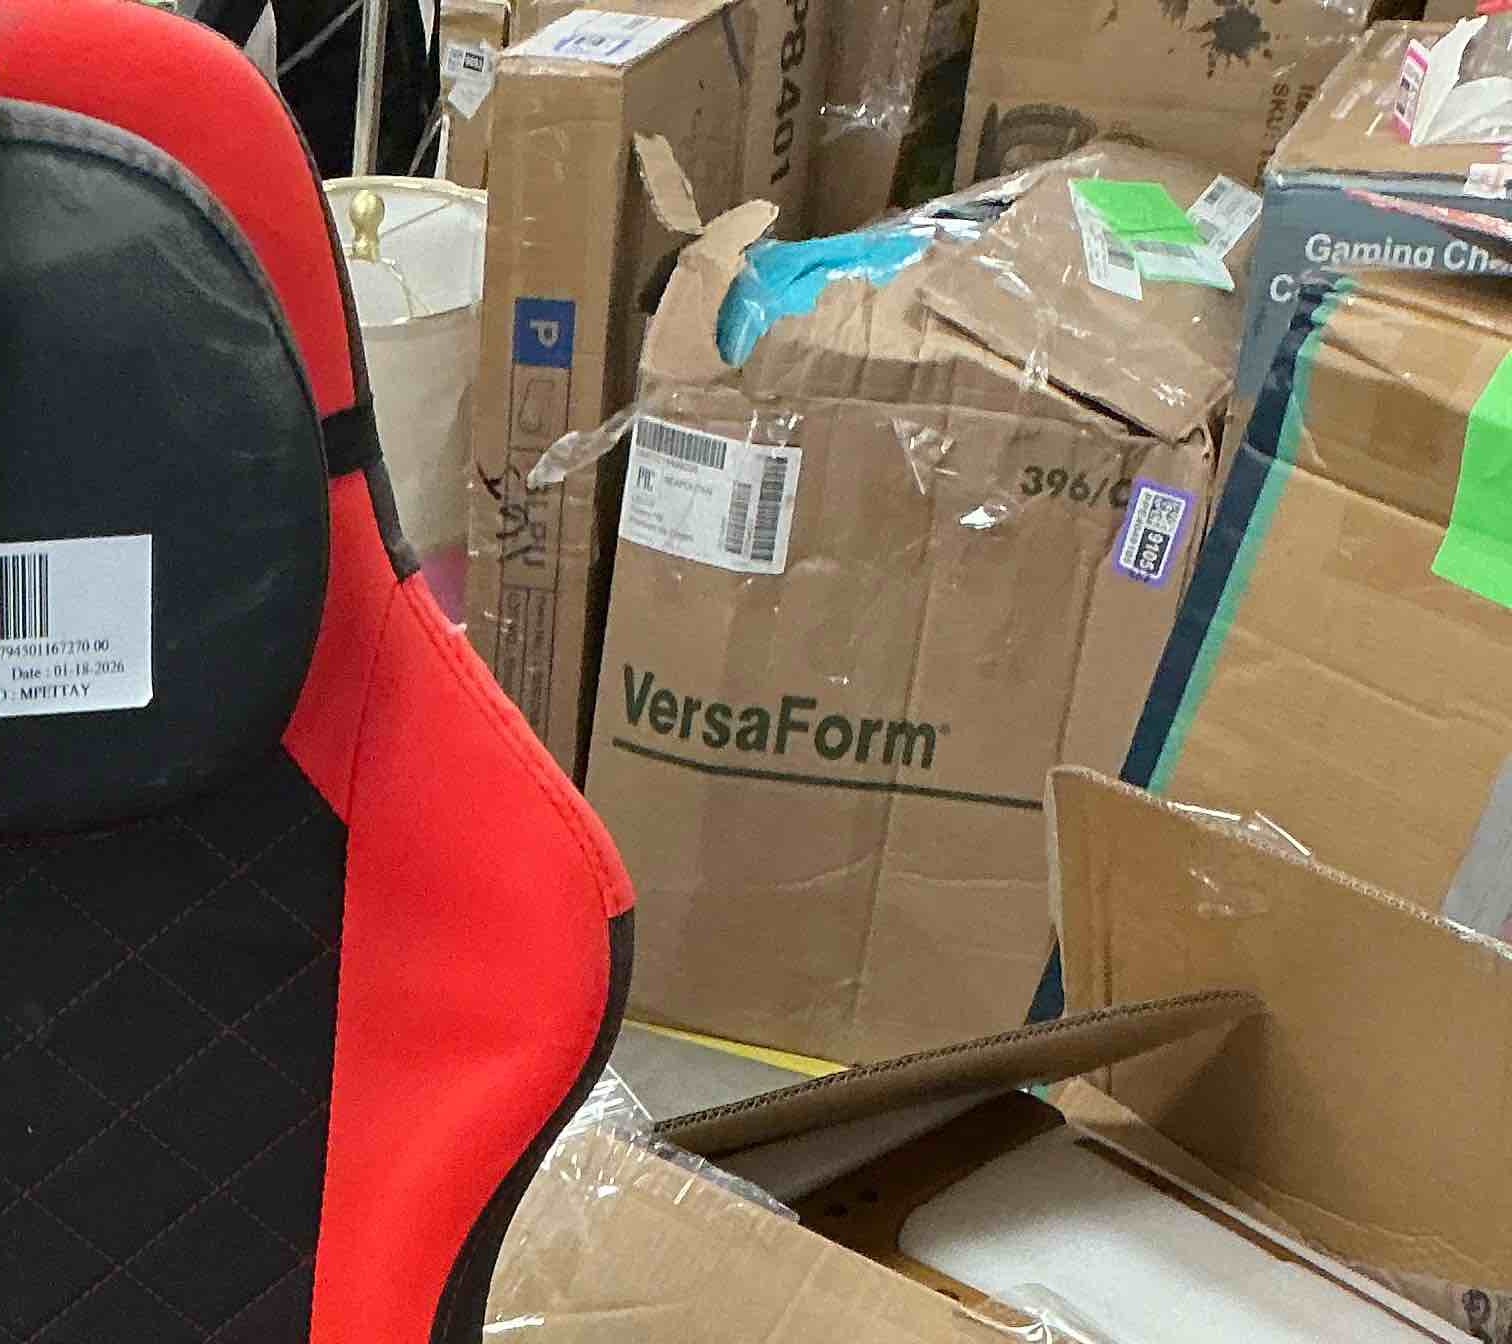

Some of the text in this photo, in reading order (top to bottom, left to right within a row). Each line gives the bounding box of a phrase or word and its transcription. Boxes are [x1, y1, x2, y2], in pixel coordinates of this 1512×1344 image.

[1305, 233, 1434, 272] Gaming
[11, 666, 42, 682] Date
[623, 663, 938, 770] VersaForm
